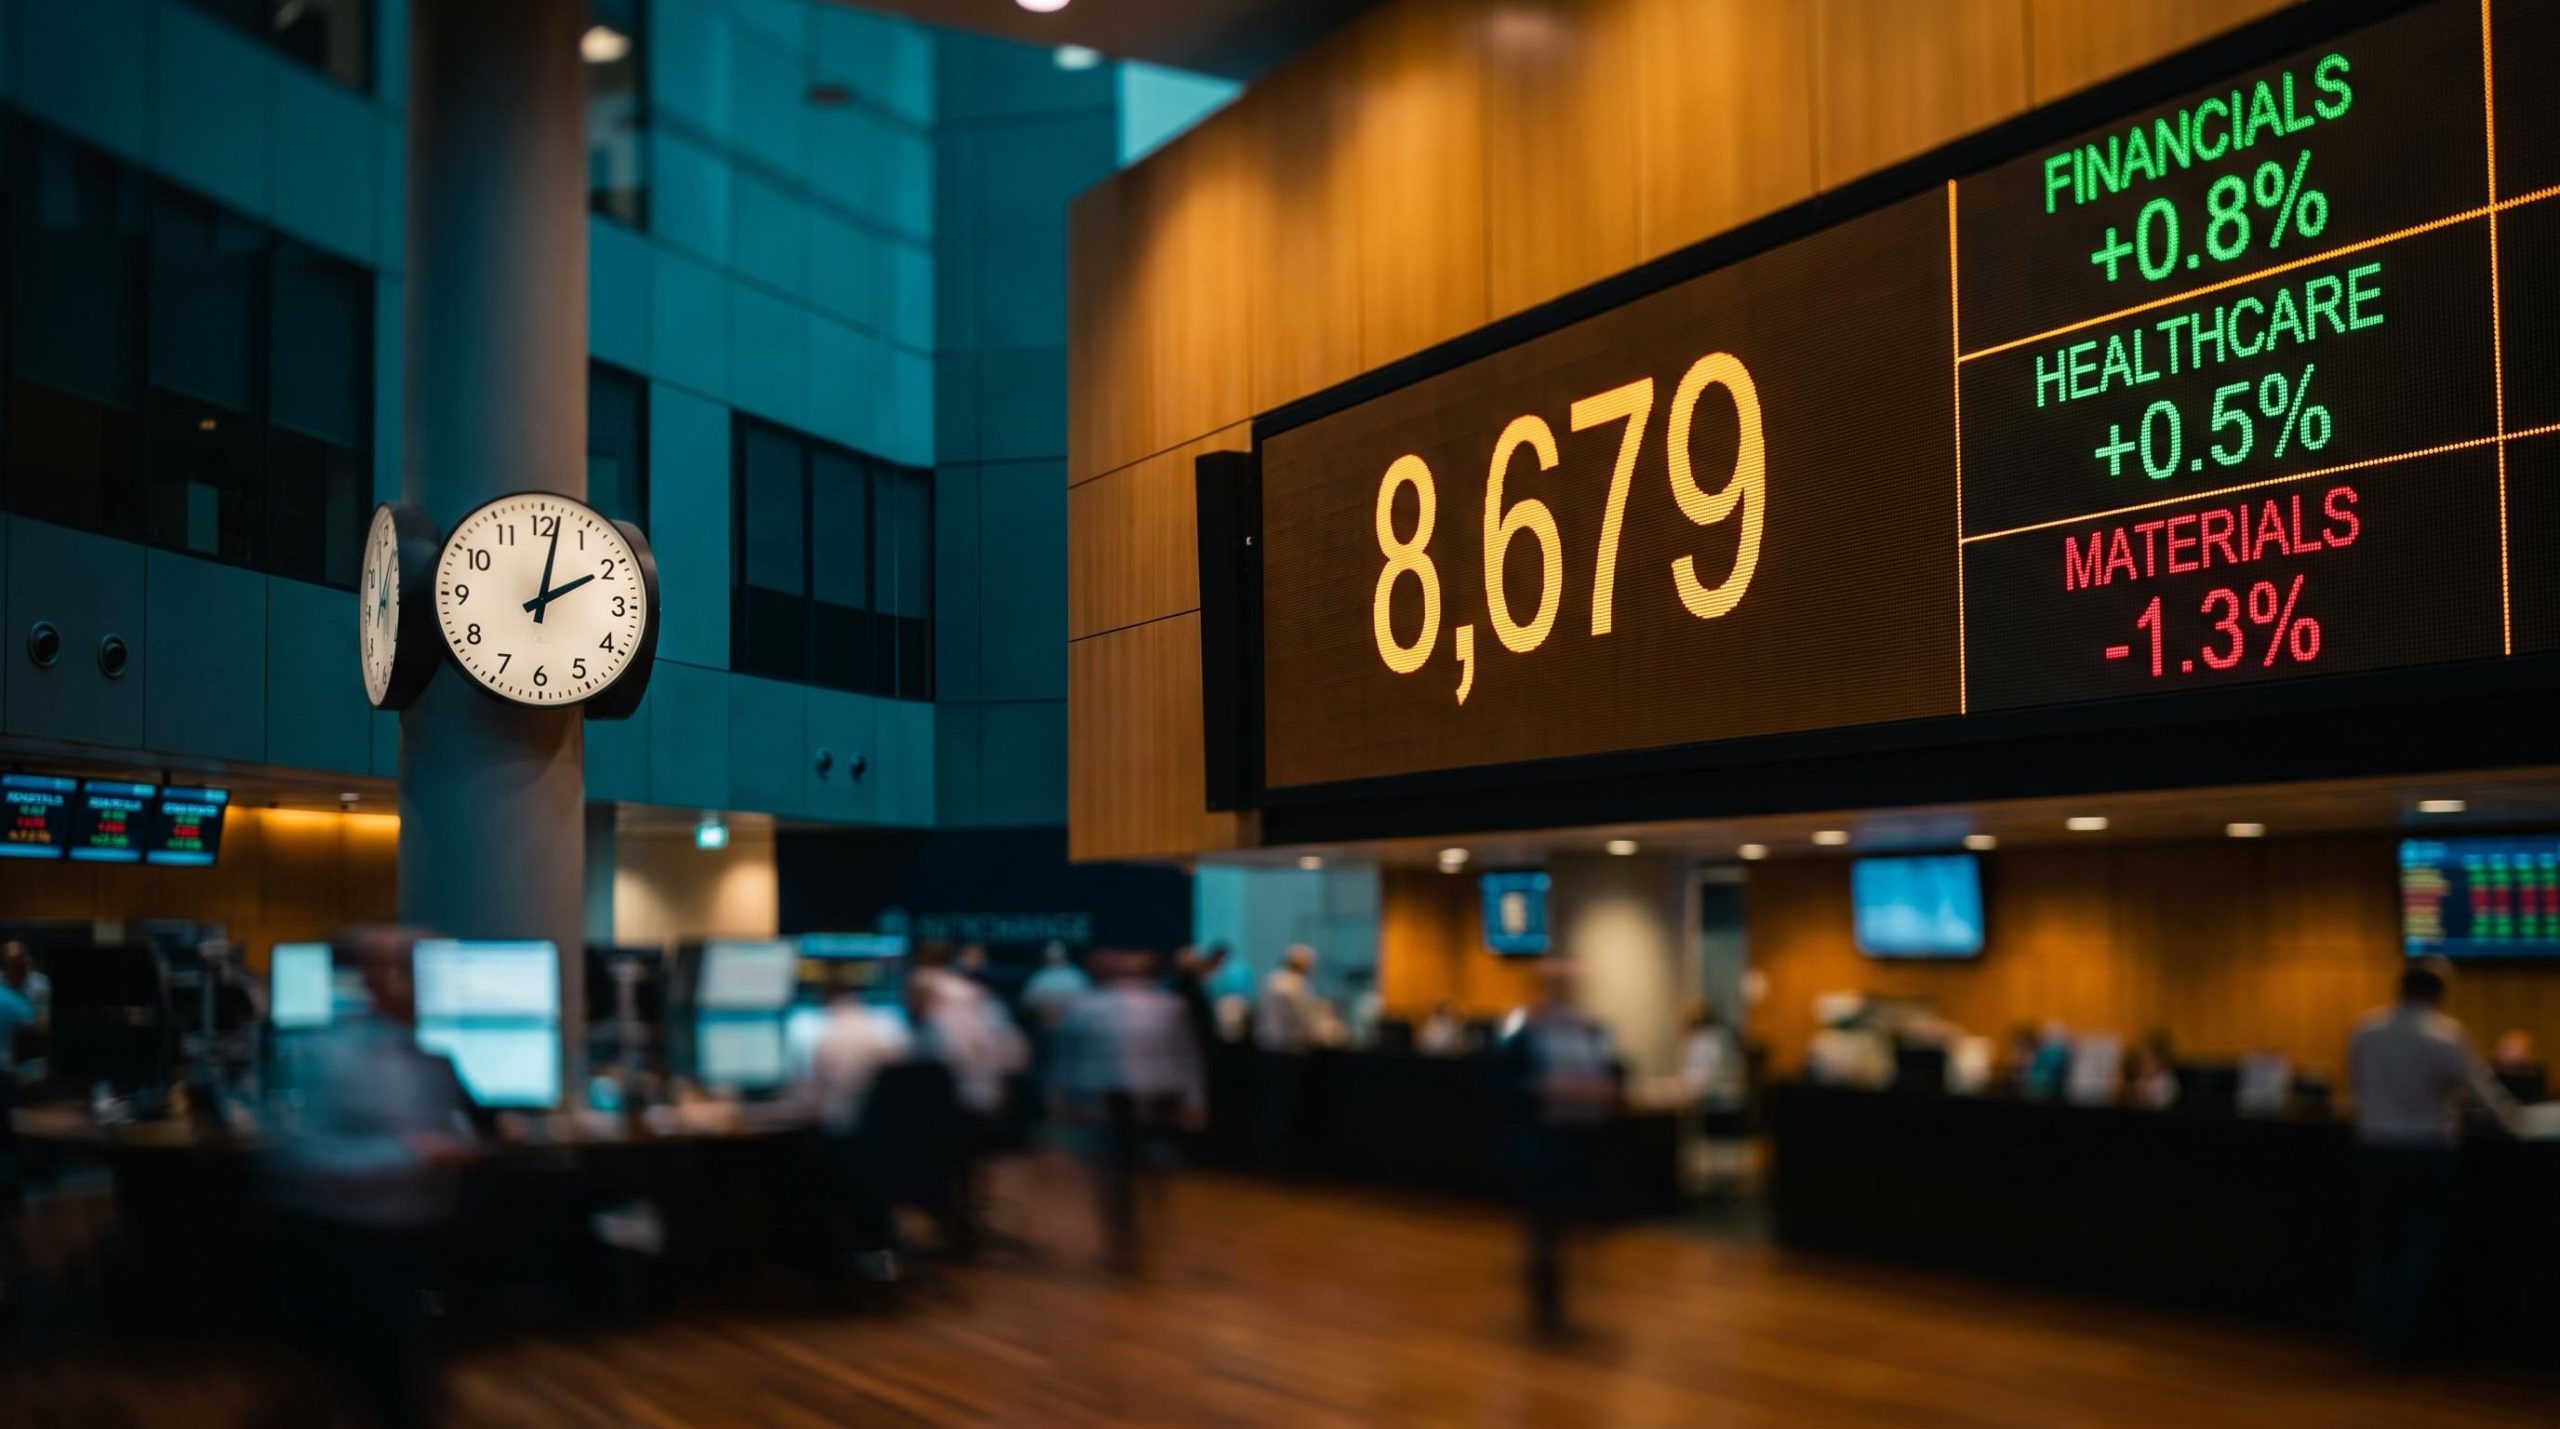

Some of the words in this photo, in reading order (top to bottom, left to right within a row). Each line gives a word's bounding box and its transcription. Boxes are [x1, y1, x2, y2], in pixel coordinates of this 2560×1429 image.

[2045, 54, 2352, 213] FINANCIALS
[2091, 150, 2328, 281] +0.8%
[2036, 262, 2384, 407] HEALTHCARE
[2095, 364, 2331, 479] +0.5%
[497, 524, 514, 545] 11
[531, 515, 554, 537] 12
[1374, 352, 1766, 705] 8,679
[578, 530, 583, 550] 1
[2066, 487, 2359, 590] MATERIALS
[467, 549, 490, 571] 10
[601, 559, 614, 580] 2
[455, 584, 469, 605] 9
[612, 596, 625, 617] 3
[467, 623, 481, 645] 8
[2106, 575, 2319, 676] -1.3%
[599, 632, 614, 653] 4
[498, 653, 512, 674] 7
[572, 658, 586, 679] 5
[533, 665, 547, 686] 6
